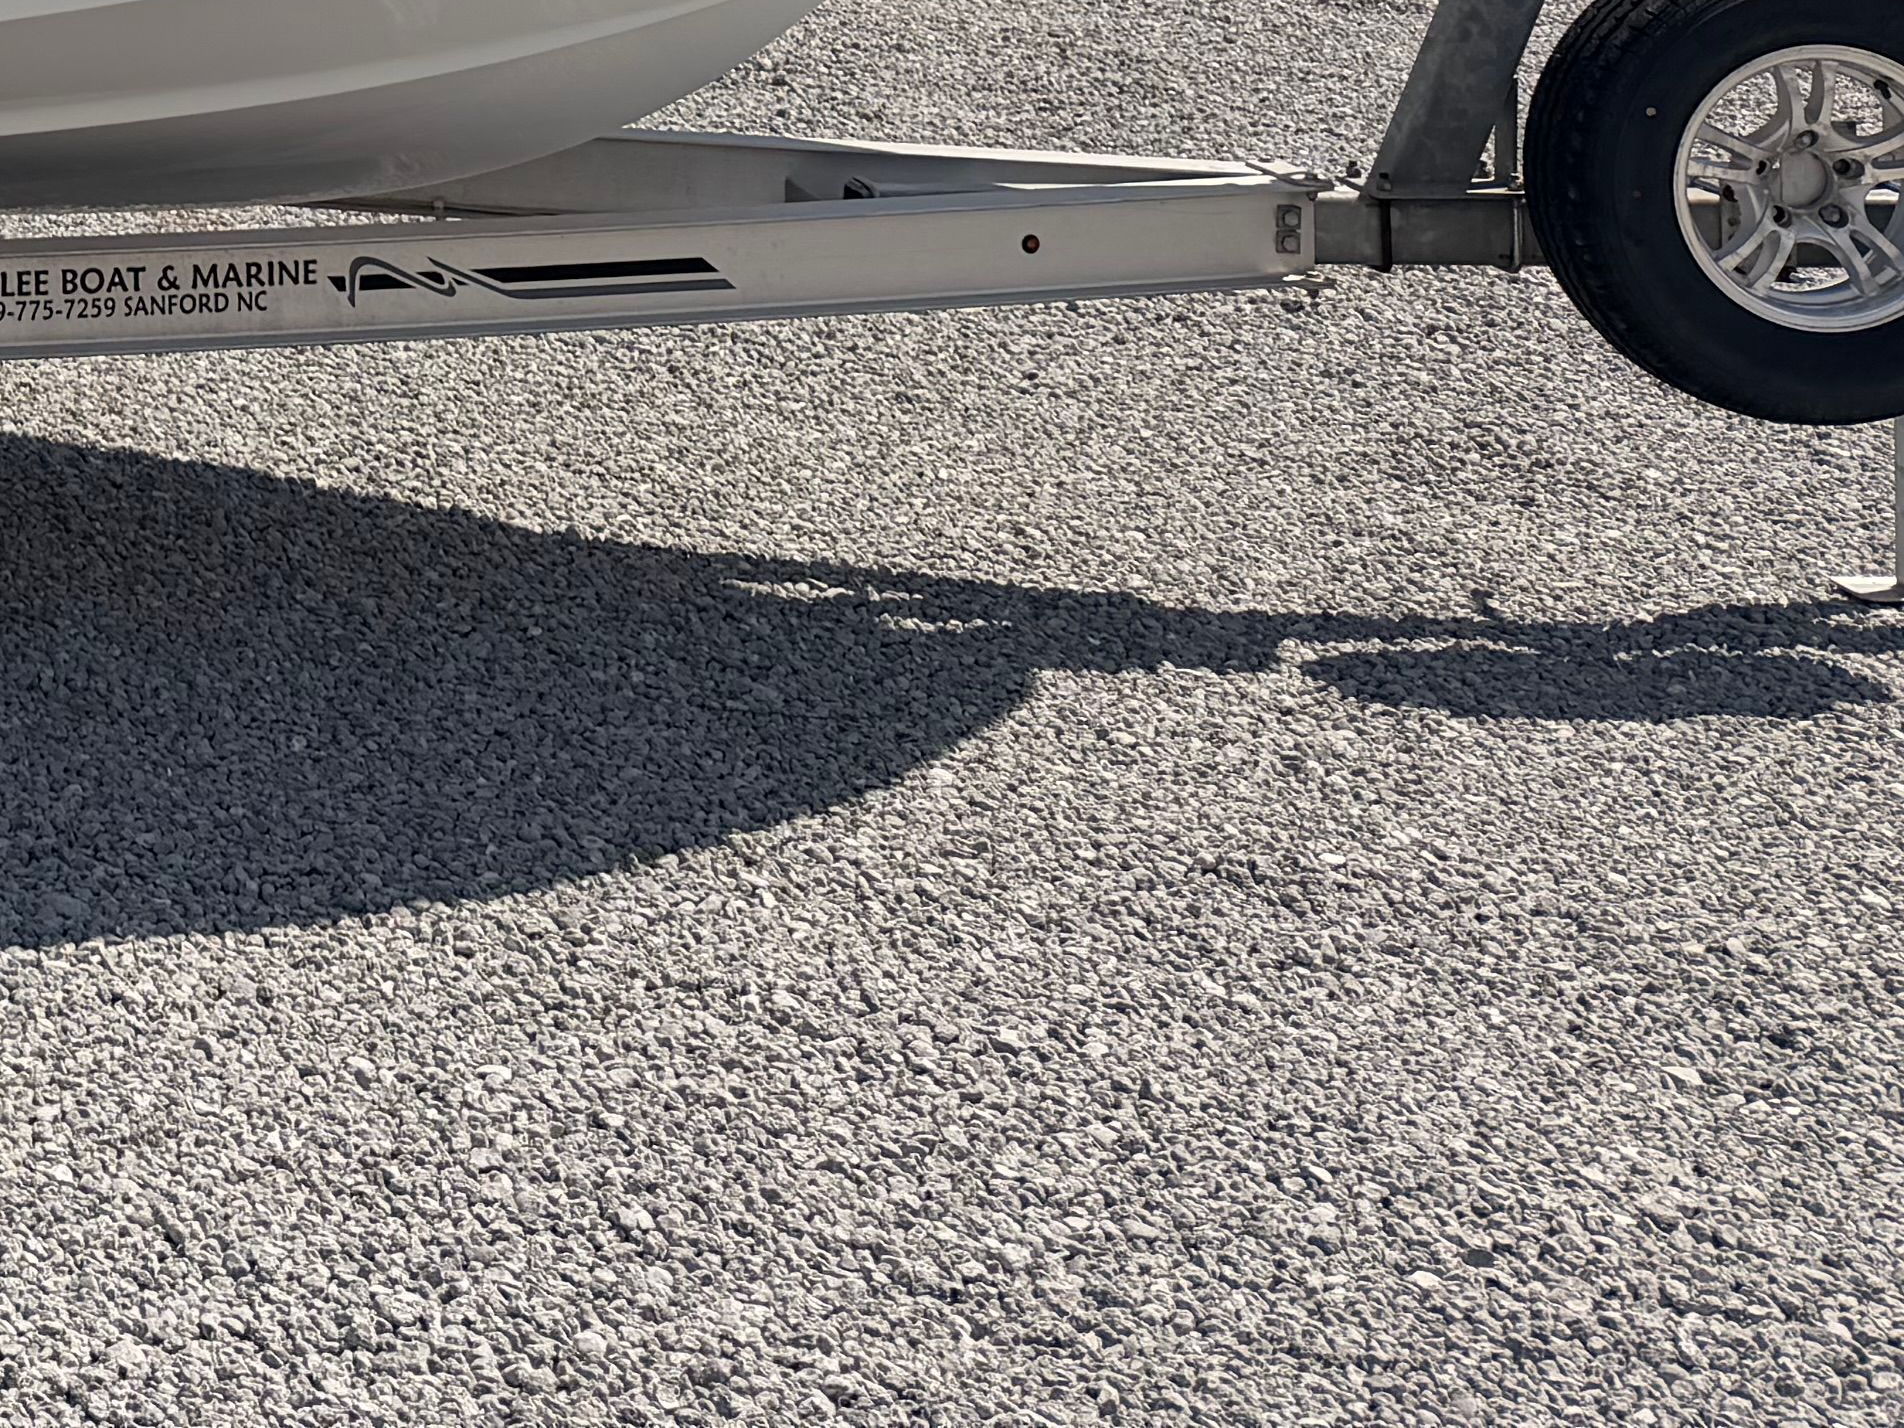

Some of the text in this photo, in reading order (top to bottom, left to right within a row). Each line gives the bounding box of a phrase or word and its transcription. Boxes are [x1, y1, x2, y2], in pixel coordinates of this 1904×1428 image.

[61, 266, 146, 294] BOAT
[157, 265, 180, 291] &
[191, 259, 318, 289] MARINE
[124, 292, 229, 317] SANFORD
[237, 290, 268, 312] NC
